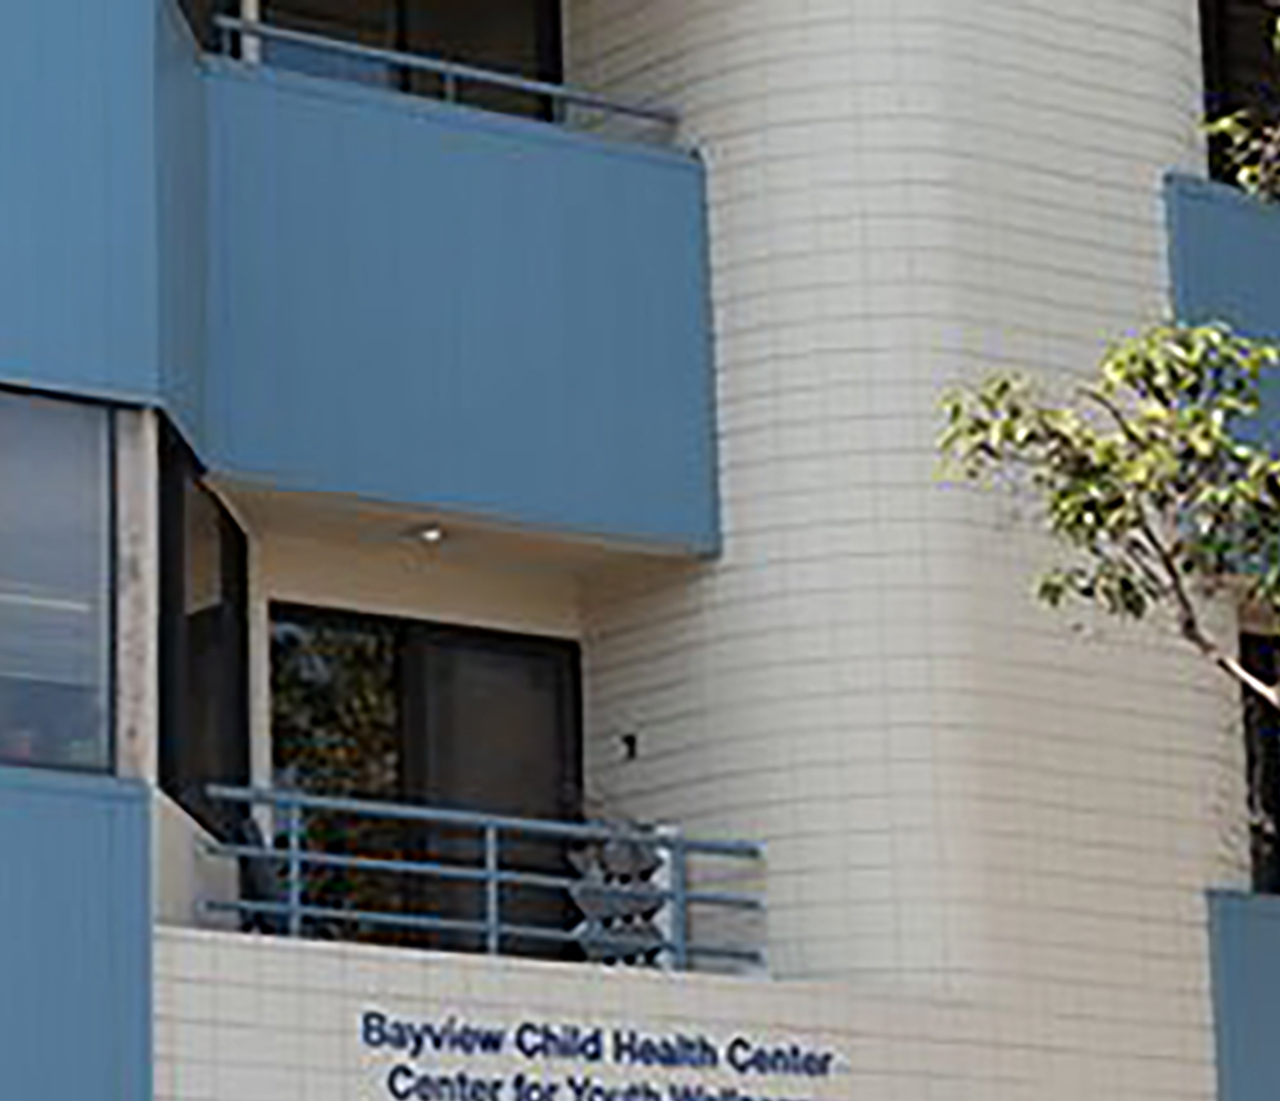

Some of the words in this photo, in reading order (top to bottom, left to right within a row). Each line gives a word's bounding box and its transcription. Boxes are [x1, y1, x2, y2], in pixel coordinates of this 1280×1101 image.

[362, 1011, 506, 1060] Bayview
[514, 1021, 603, 1063] Child
[612, 1029, 719, 1070] Health
[725, 1037, 834, 1078] Center
